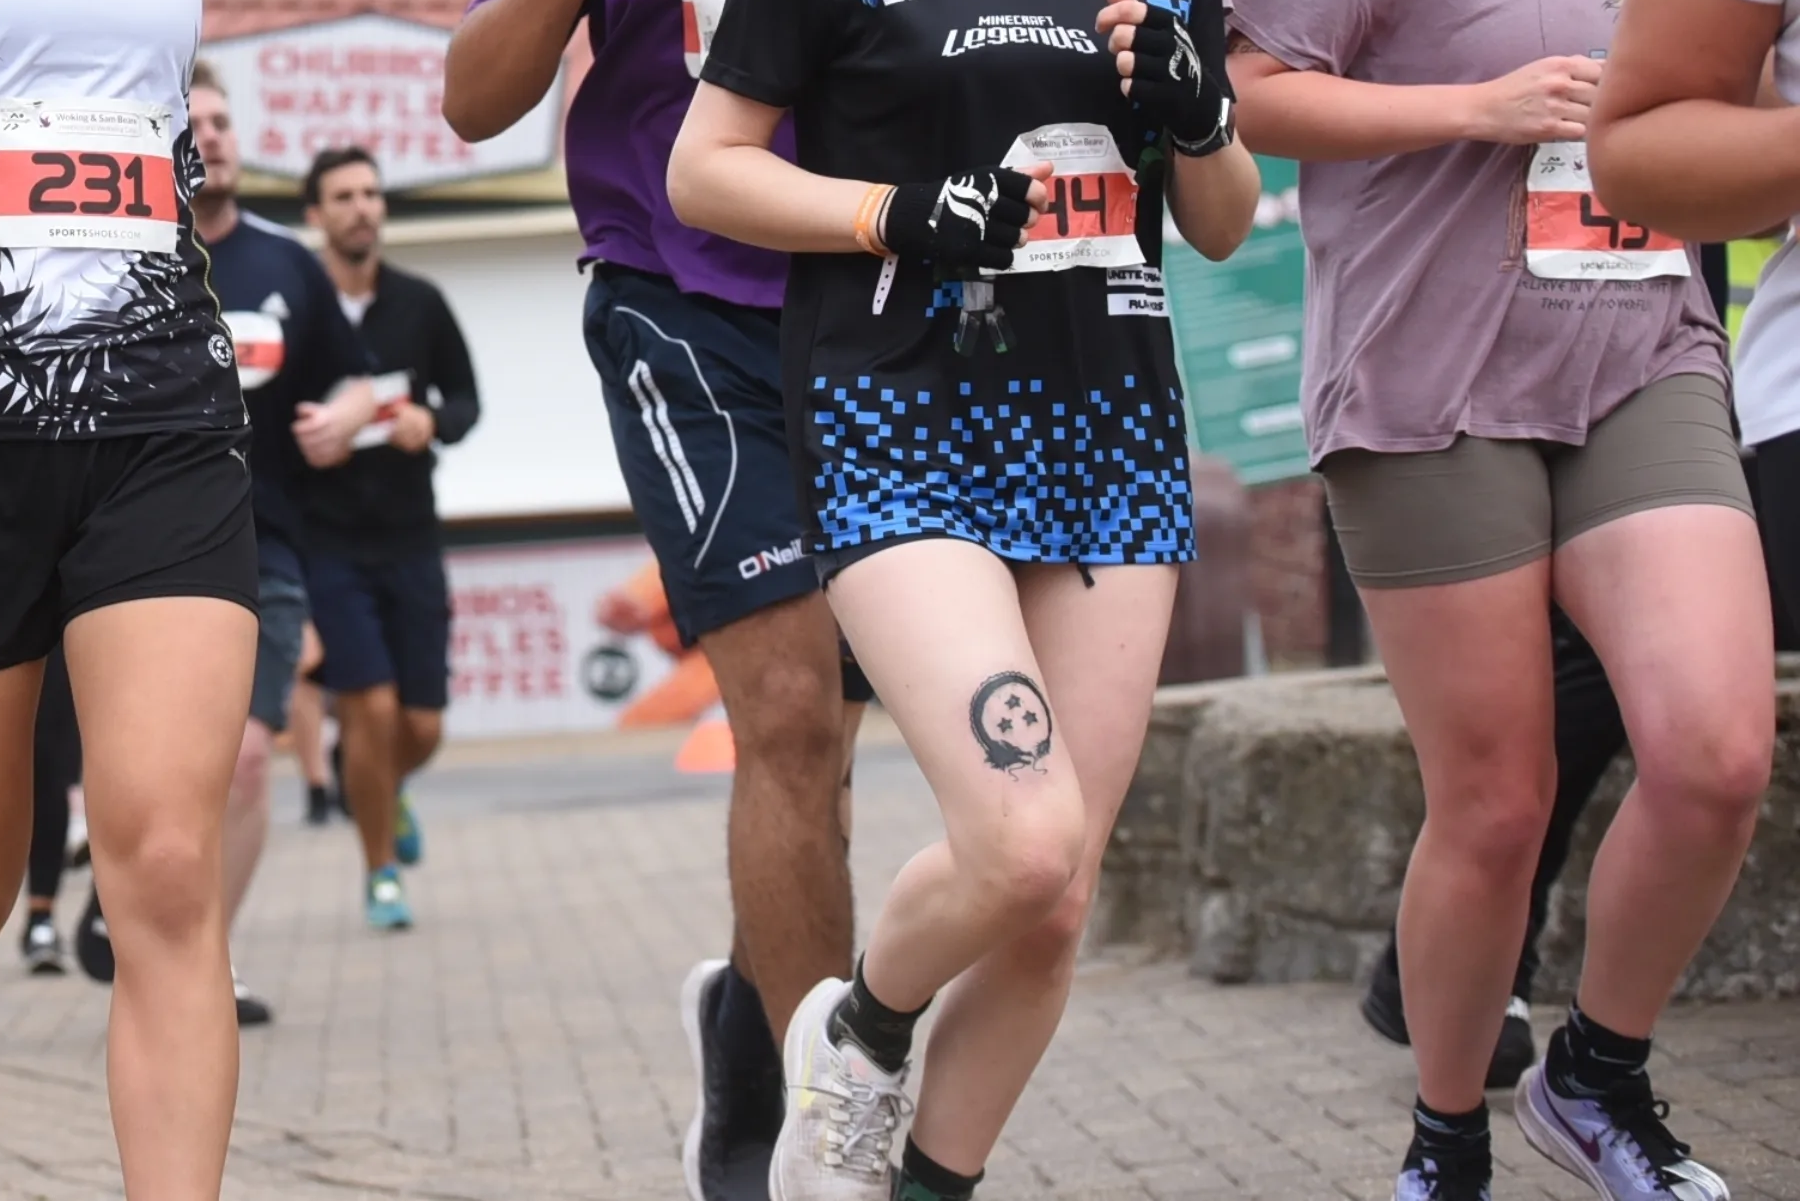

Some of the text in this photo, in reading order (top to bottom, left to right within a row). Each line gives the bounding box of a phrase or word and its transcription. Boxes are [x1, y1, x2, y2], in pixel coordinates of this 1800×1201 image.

[978, 15, 1055, 27] MINECRAFT
[56, 113, 89, 124] Woking
[99, 114, 116, 123] Sam
[29, 152, 152, 217] 231
[49, 228, 141, 240] SPORTSSHOES.COM
